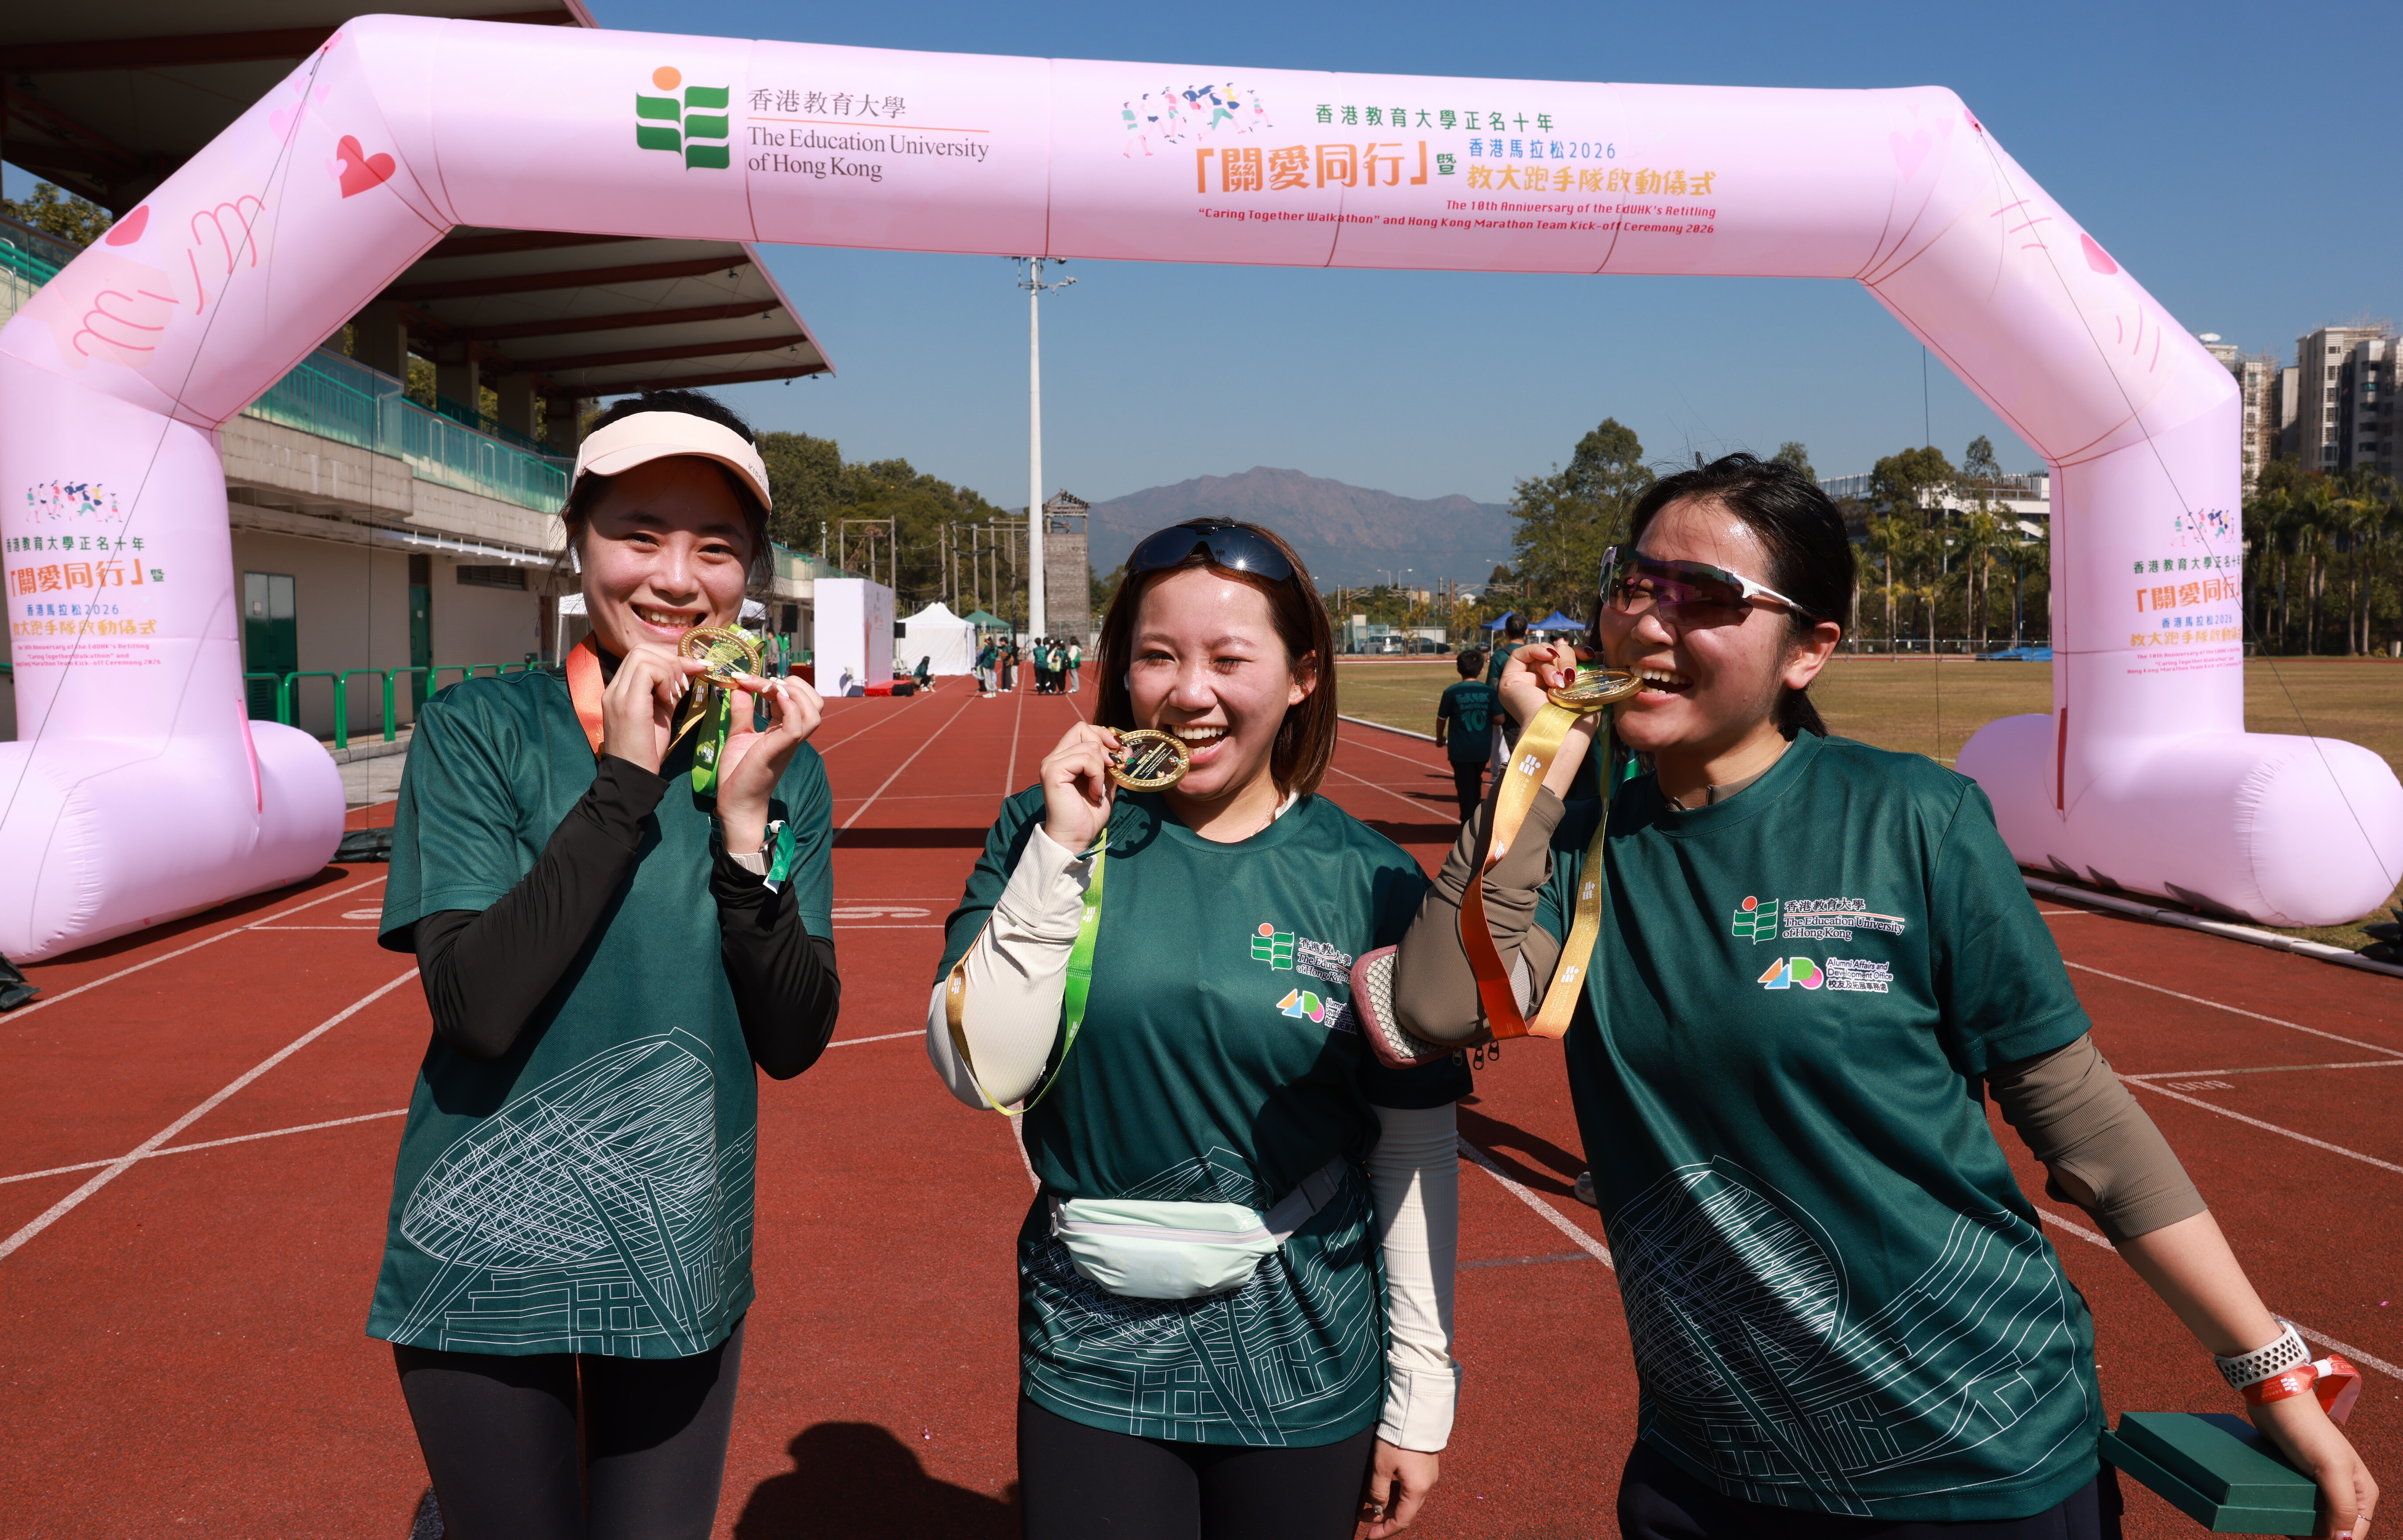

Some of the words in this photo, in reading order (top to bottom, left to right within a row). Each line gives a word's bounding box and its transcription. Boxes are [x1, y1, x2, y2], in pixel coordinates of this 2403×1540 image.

[747, 89, 906, 119] 香港教育大學
[1316, 103, 1554, 133] 香港教育大學正名十年
[747, 126, 784, 147] The
[790, 128, 886, 153] Education
[890, 134, 990, 163] University
[1469, 138, 1616, 160] 香港馬拉松2026
[748, 153, 768, 171] of
[772, 154, 827, 179] Hong
[830, 157, 882, 182] Kong
[1467, 164, 1716, 196] 教大跑手隊啟動儀式
[1446, 200, 1467, 211] The
[1471, 200, 1498, 212] 10th
[1501, 201, 1574, 216] Anniversary
[1577, 202, 1591, 214] of
[1593, 202, 1612, 214] the
[1666, 206, 1717, 219] Retitling
[1248, 209, 1304, 222] Together
[1383, 215, 1405, 226] and
[1408, 216, 1438, 228] Hong
[1440, 217, 1472, 230] Kong
[1474, 219, 1533, 230] Marathon
[1536, 220, 1567, 231] Team
[1570, 220, 1622, 232] Kick-off
[1623, 222, 1683, 235] Ceremony
[1686, 224, 1714, 234] 2026
[1785, 898, 1866, 912] 香港教育大學
[1783, 928, 1793, 938] of
[1793, 927, 1823, 939] Hong
[1825, 928, 1852, 941] Kong
[1784, 917, 1804, 927] The
[1804, 916, 1854, 927] Education
[1856, 917, 1904, 934] University
[1298, 953, 1314, 964] The
[1828, 958, 1852, 968] Alumni
[1853, 961, 1875, 970] Affairs
[1876, 962, 1888, 970] and
[1305, 966, 1328, 980] Hong
[1828, 969, 1872, 979] Development
[1873, 972, 1892, 980] Office
[1828, 979, 1887, 992] 校友及拓展事務處
[1326, 998, 1347, 1010] Alumni
